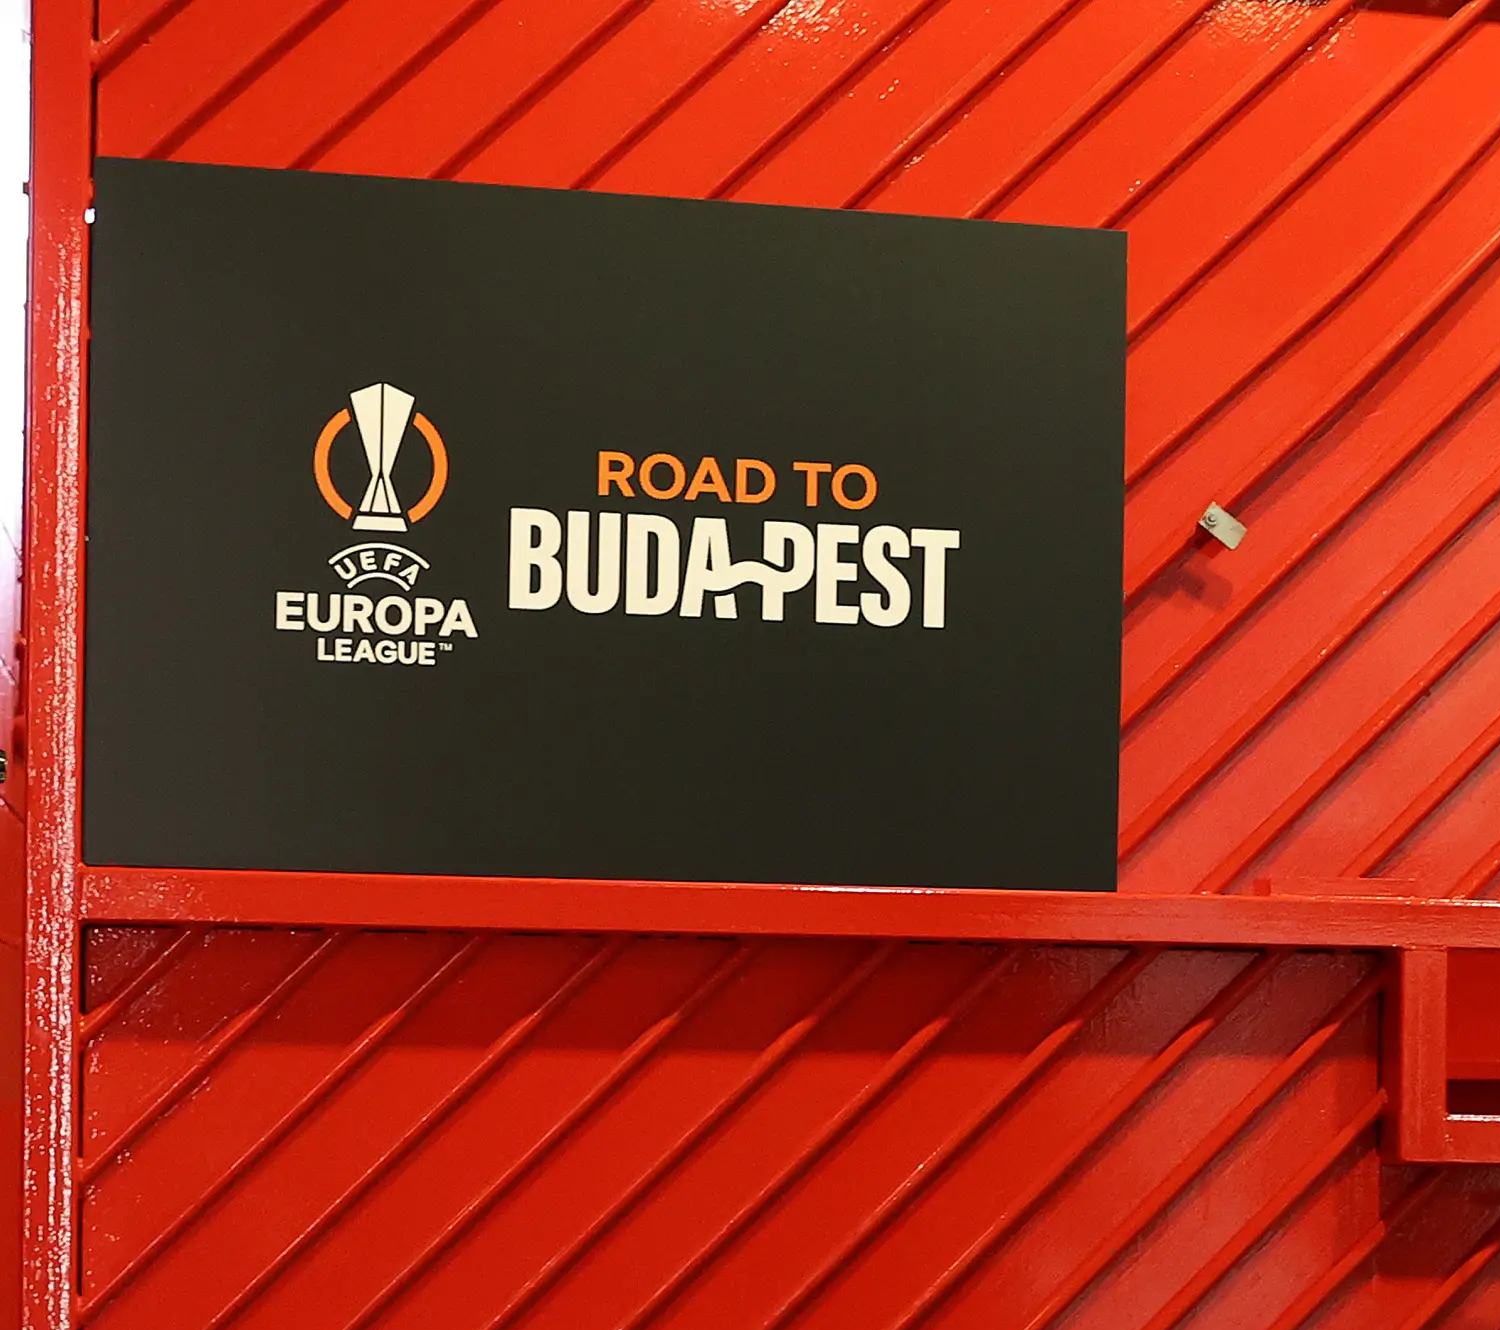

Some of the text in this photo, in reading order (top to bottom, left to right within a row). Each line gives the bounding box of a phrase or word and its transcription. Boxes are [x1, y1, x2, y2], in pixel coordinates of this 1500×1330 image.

[598, 451, 877, 509] ROAD TO
[334, 550, 420, 586] UEFA
[509, 507, 960, 629] BUDAPEST
[276, 592, 479, 639] EUROPA
